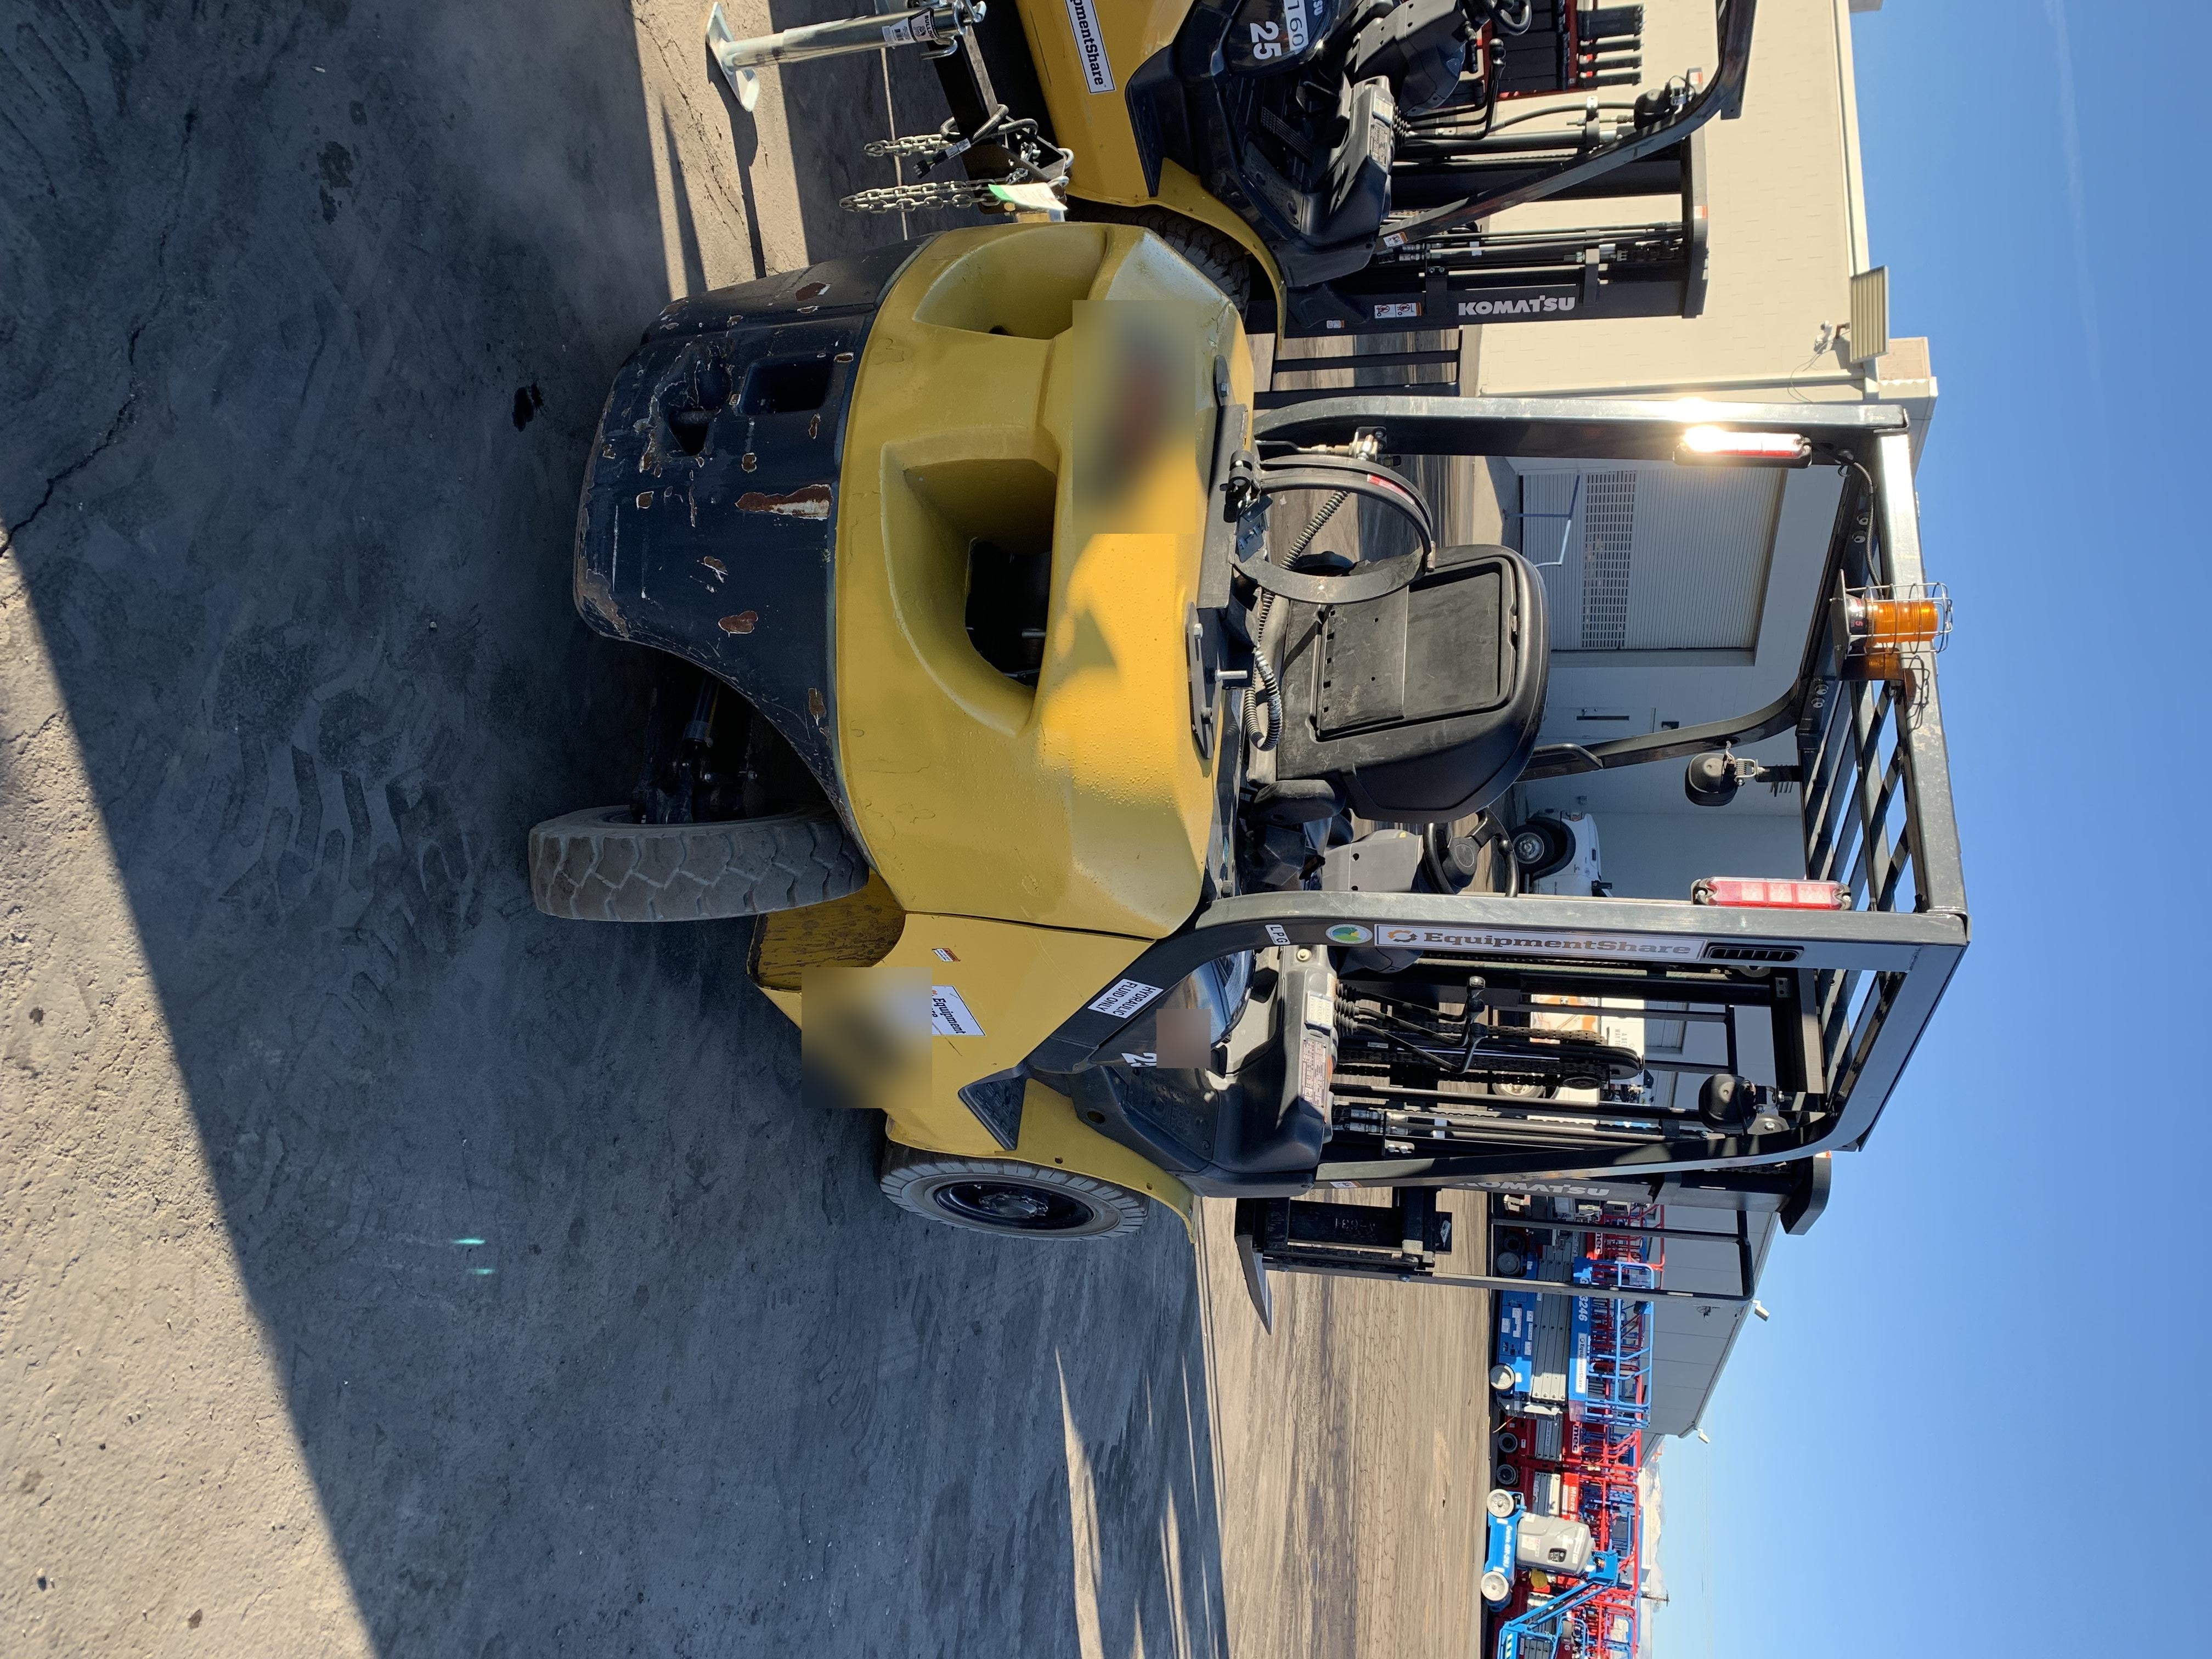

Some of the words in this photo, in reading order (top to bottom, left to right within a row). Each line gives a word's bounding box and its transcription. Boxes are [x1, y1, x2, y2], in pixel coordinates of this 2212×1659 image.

[1250, 21, 1282, 59] 25
[1458, 295, 1576, 316] KOMATSU
[1270, 927, 1288, 943] LPG
[1424, 933, 1691, 953] EquipmentShare
[1111, 982, 1138, 998] FLUID
[1096, 997, 1118, 1012] ONLY
[1113, 986, 1156, 1015] HYDRAULIC
[932, 998, 963, 1034] Equipment
